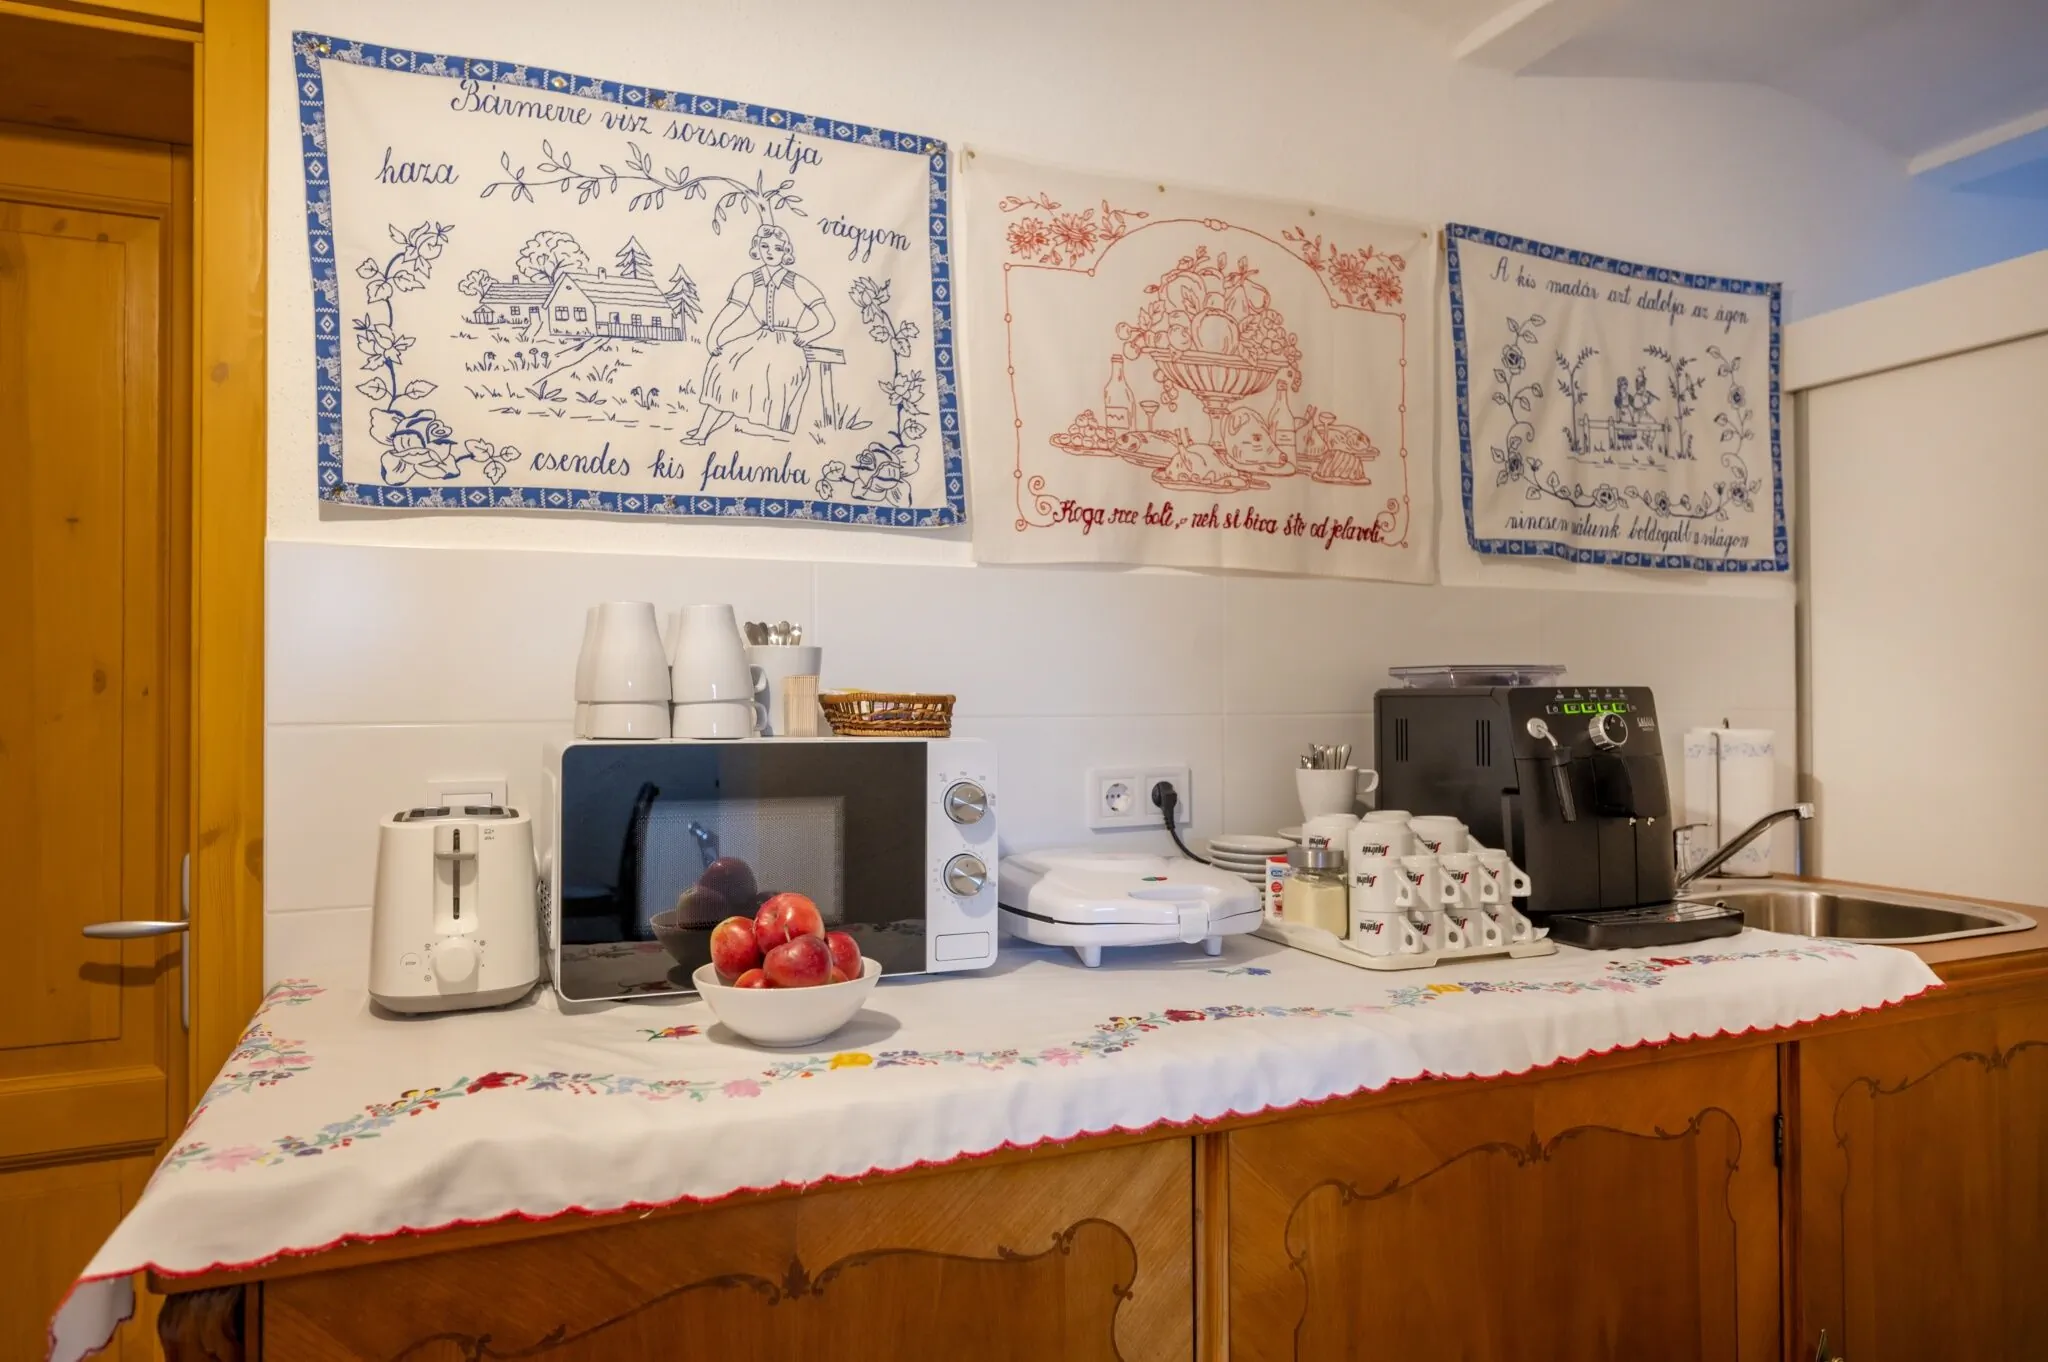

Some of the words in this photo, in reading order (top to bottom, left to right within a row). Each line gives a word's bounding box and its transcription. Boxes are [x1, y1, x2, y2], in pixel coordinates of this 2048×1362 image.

[450, 79, 592, 126] Bármerre
[600, 106, 652, 135] visz
[662, 120, 756, 154] sorsom
[763, 133, 823, 174] utja
[374, 146, 460, 184] haza
[817, 214, 912, 263] vágyom
[1490, 256, 1510, 282] A
[1514, 264, 1537, 289] kis
[529, 442, 631, 477] csendes
[648, 450, 685, 479] kis
[700, 450, 811, 491] falumba
[1052, 500, 1105, 535] Koga
